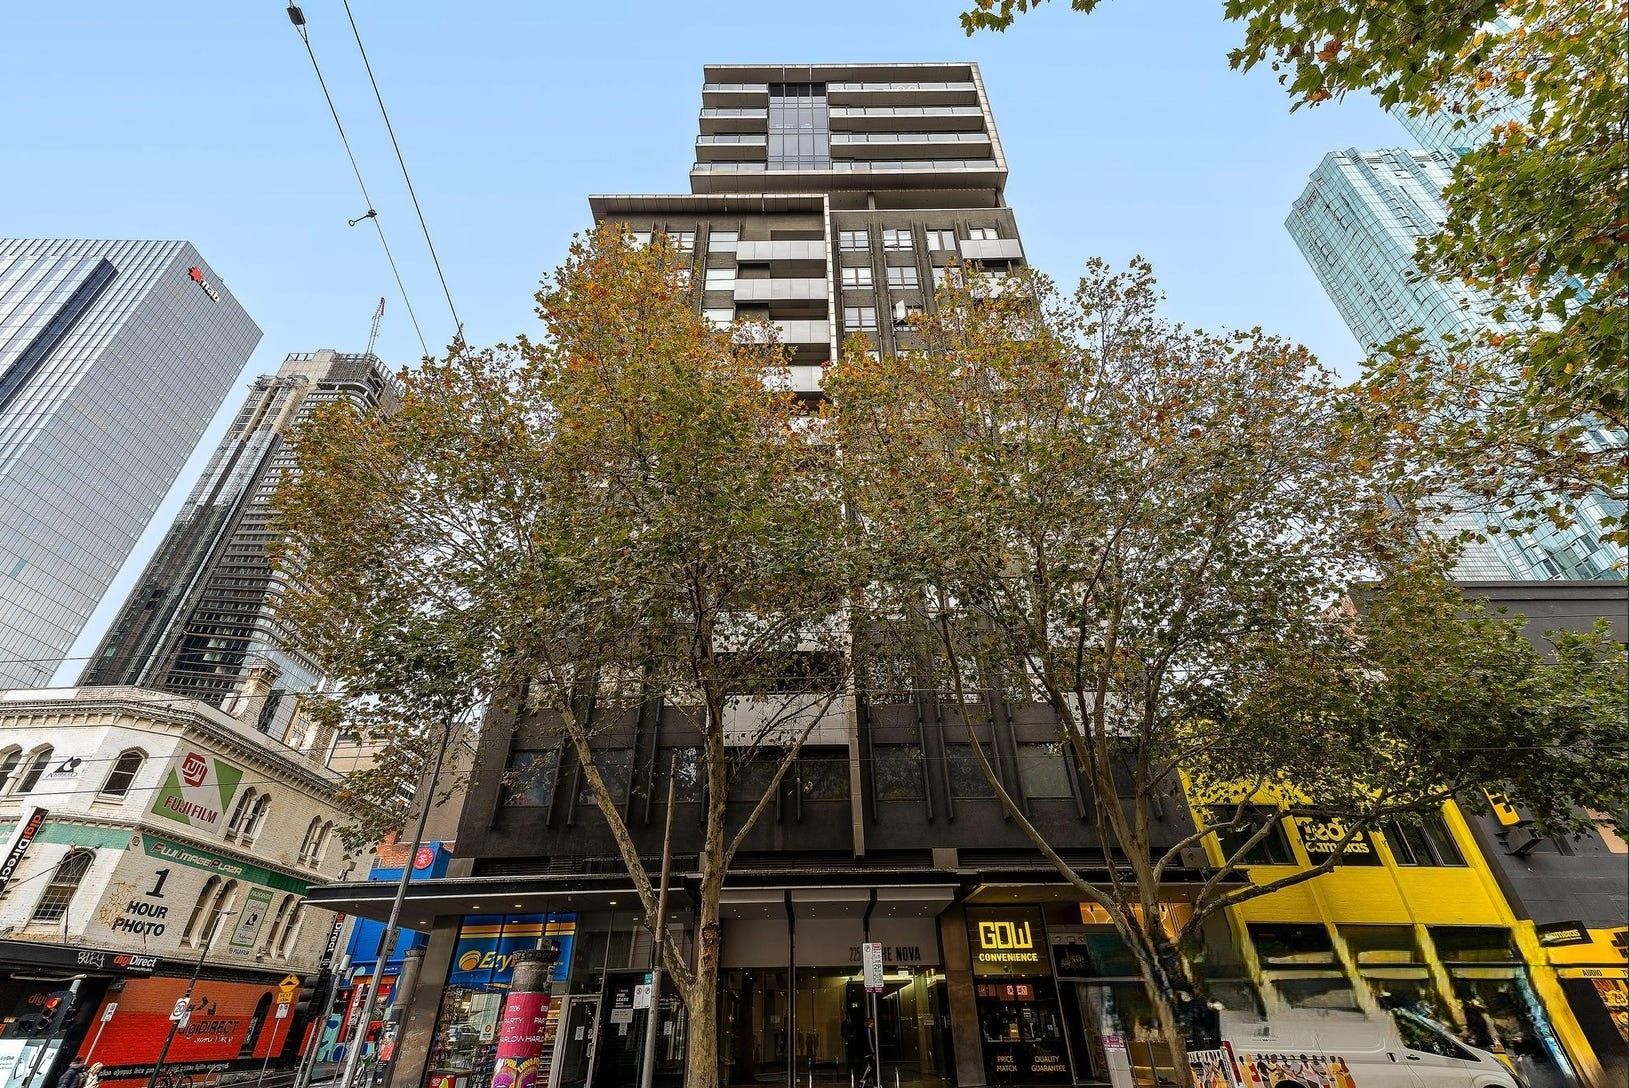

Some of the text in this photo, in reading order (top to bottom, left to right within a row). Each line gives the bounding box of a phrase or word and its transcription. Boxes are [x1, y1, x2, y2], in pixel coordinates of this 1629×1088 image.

[200, 280, 220, 302] nab
[1305, 842, 1370, 853] camras
[146, 868, 171, 898] 1
[126, 900, 169, 919] HOUR
[112, 917, 166, 936] PHOTO
[978, 921, 1033, 949] GOW
[113, 954, 158, 968] digiDirect
[896, 946, 921, 962] NOVA
[979, 953, 1039, 962] CONVENIENCE
[479, 951, 517, 972] Ezy
[1583, 969, 1603, 977] AUDIO
[997, 1055, 1014, 1063] PRICE
[1034, 1055, 1060, 1063] QUALITY
[996, 1064, 1018, 1072] MATCH
[1031, 1064, 1067, 1072] GUARANTEE
